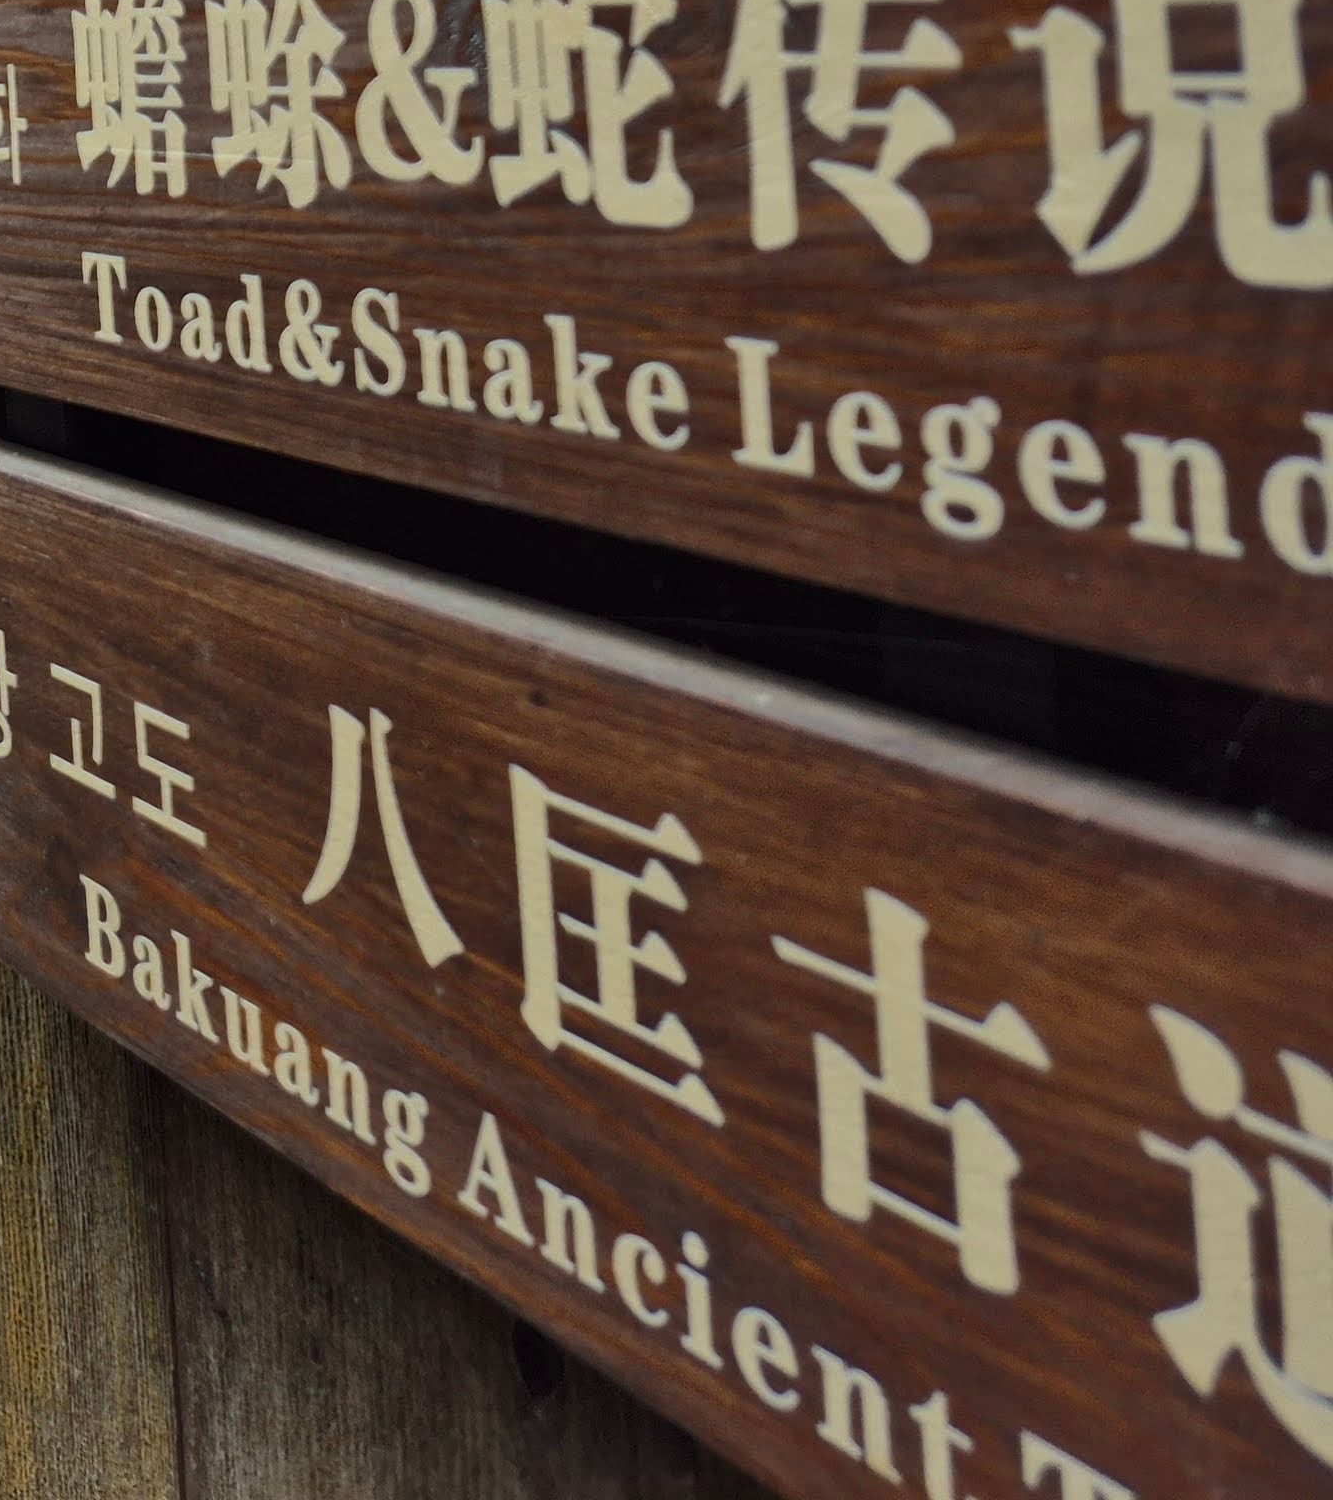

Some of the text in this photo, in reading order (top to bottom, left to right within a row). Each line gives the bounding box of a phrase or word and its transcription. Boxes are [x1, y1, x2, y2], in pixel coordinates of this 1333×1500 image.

[80, 250, 691, 452] Toad&Snake
[49, 661, 208, 849] 고도
[79, 875, 977, 1500] Bakuang Ancient
